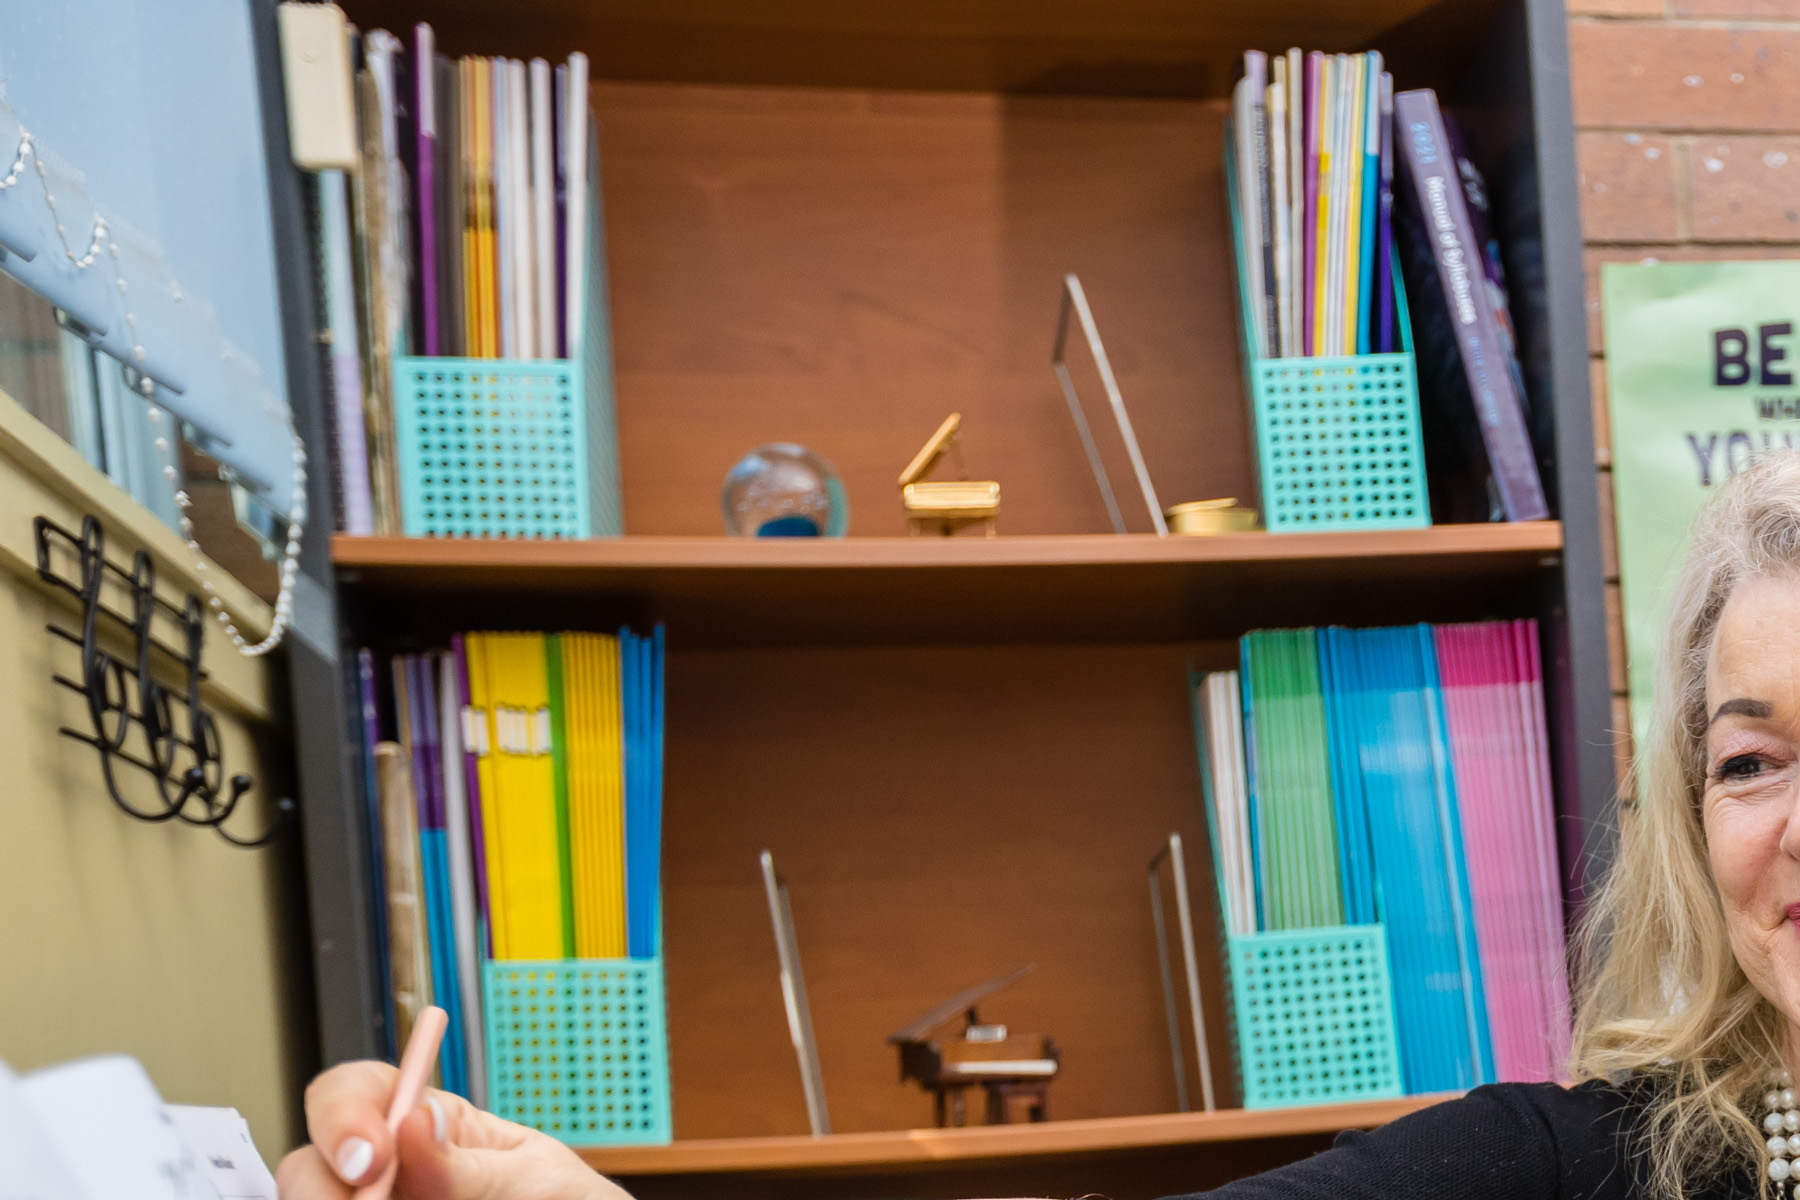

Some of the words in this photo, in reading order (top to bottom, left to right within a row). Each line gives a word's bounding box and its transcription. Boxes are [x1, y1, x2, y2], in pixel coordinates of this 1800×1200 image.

[1424, 176, 1457, 232] Manual
[1438, 231, 1461, 249] of
[1714, 322, 1793, 386] BE
